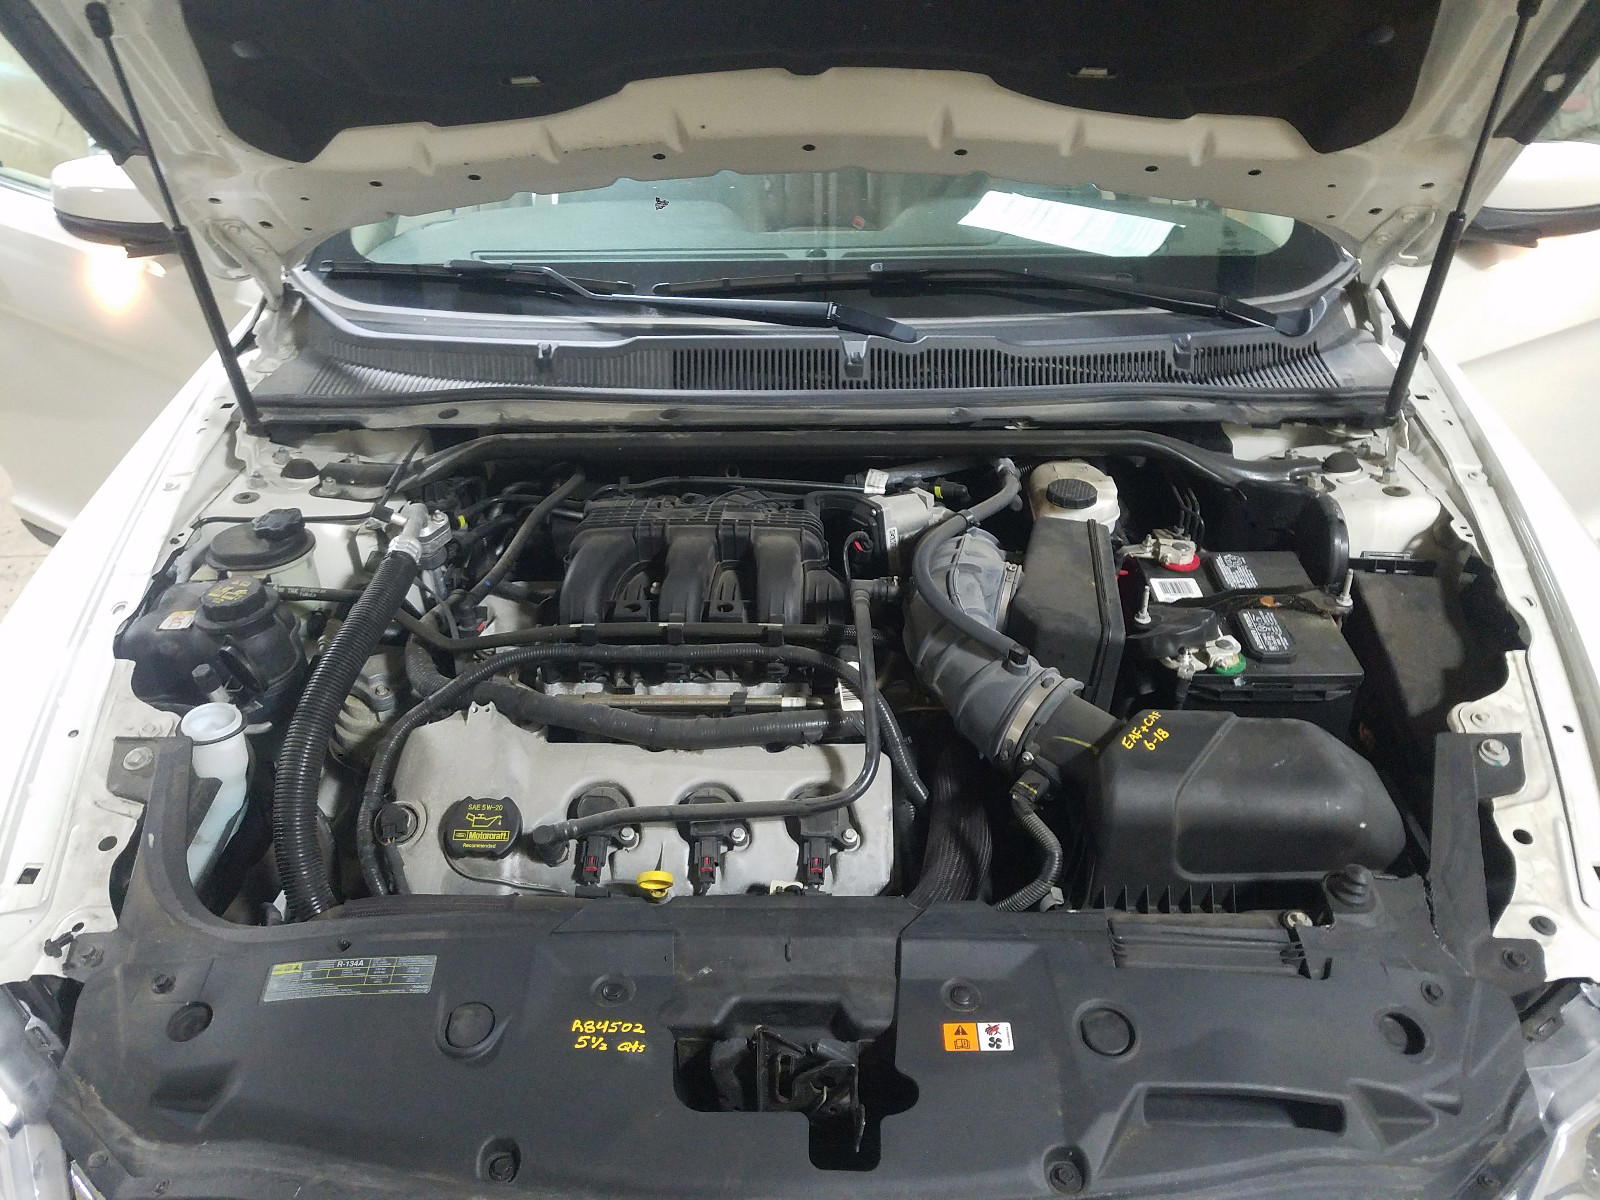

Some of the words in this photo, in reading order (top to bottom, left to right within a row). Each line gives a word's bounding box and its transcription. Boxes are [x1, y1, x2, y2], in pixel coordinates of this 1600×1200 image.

[1143, 728, 1170, 751] 6-18
[468, 803, 480, 811] SAE
[468, 831, 507, 840] Motorcraft
[336, 959, 364, 968] R-134A
